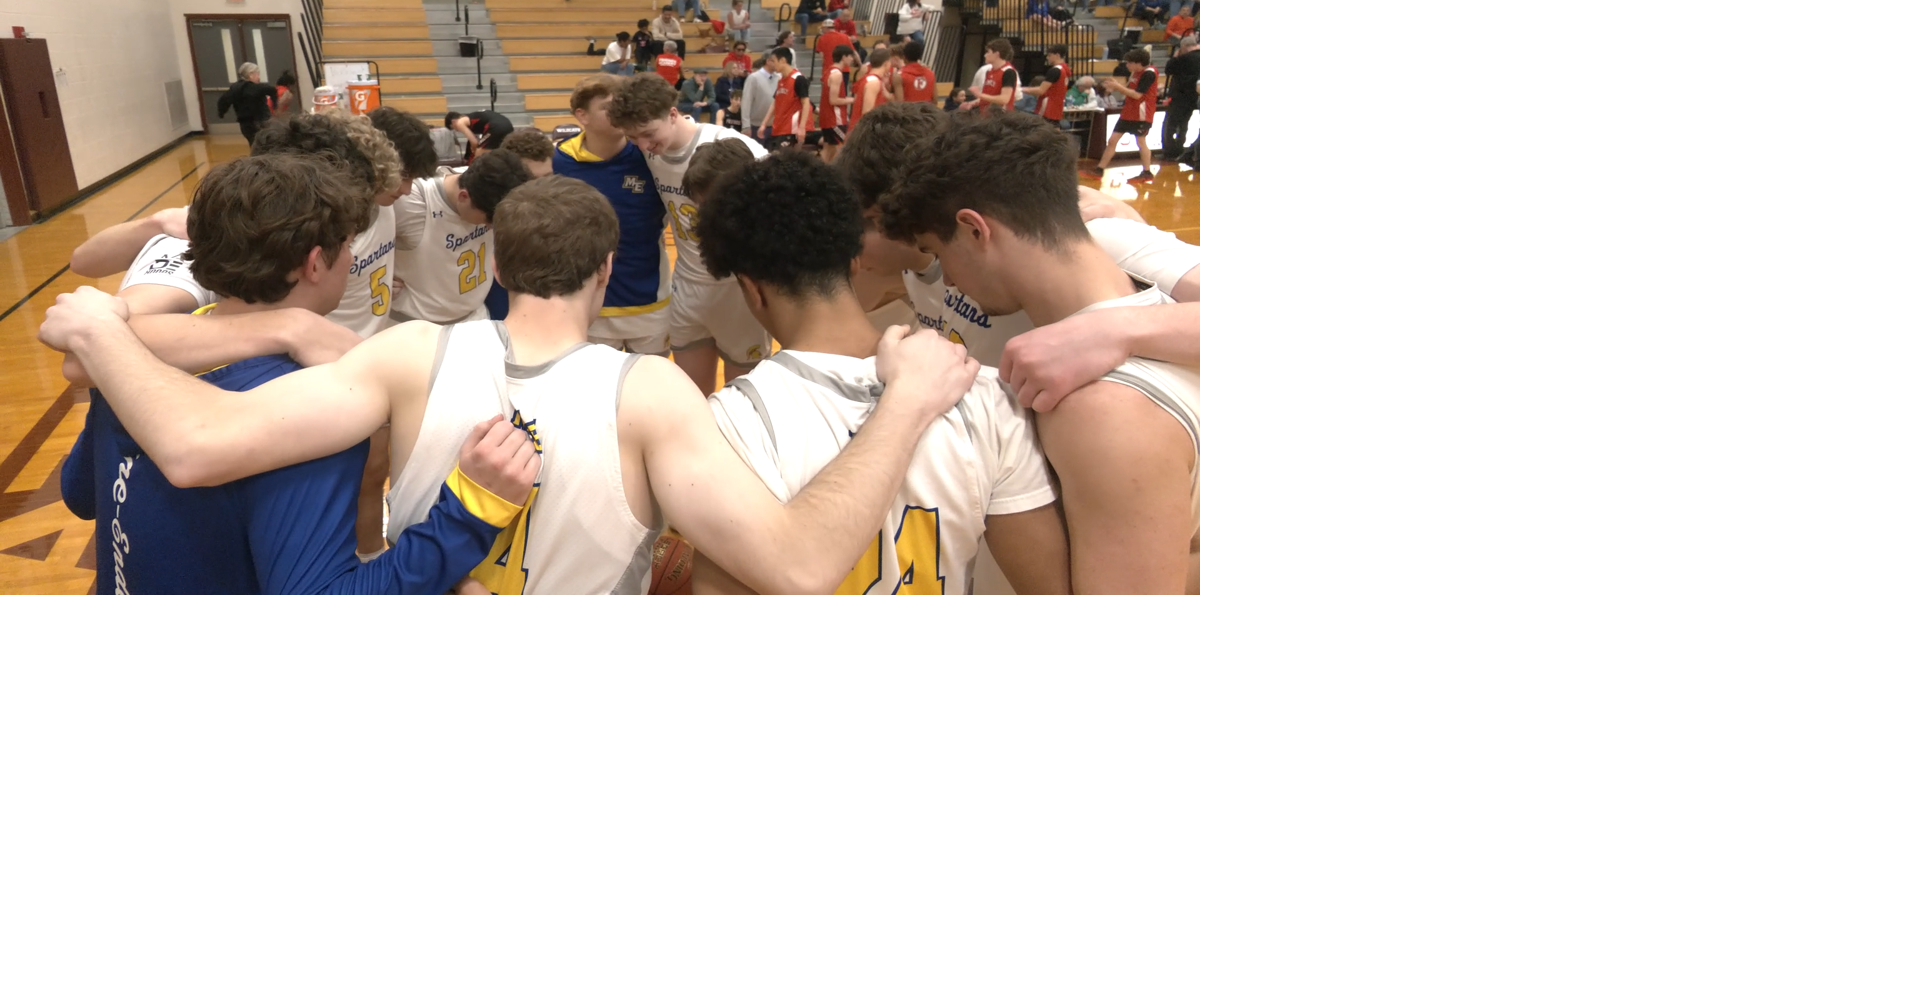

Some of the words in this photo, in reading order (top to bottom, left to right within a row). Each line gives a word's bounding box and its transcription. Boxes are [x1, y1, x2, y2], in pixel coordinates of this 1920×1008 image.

[622, 175, 646, 193] ME
[446, 225, 490, 252] Spartan
[349, 239, 396, 277] Spartan
[457, 242, 487, 295] 21
[369, 264, 390, 316] 5
